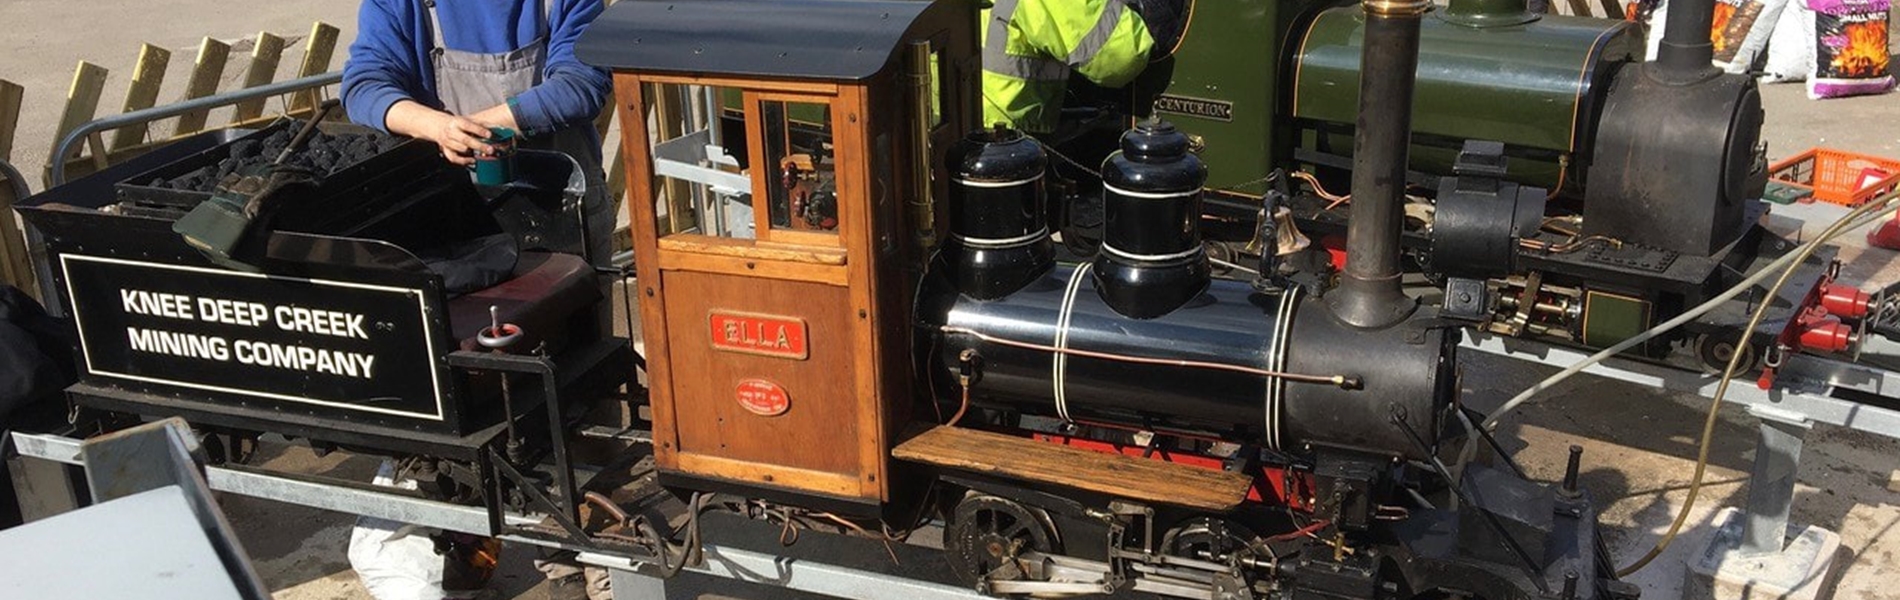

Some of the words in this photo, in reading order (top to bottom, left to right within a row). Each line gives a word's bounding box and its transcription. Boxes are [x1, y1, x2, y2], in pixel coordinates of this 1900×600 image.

[1839, 13, 1868, 22] SMALL
[1867, 11, 1887, 20] NUTS
[1159, 97, 1227, 117] CENTURION
[120, 288, 194, 320] KNEE
[197, 297, 269, 327] DEEP
[275, 305, 369, 340] CREEK
[723, 319, 792, 349] ELLA
[127, 326, 230, 361] MINING
[234, 339, 374, 379] COMPANY
